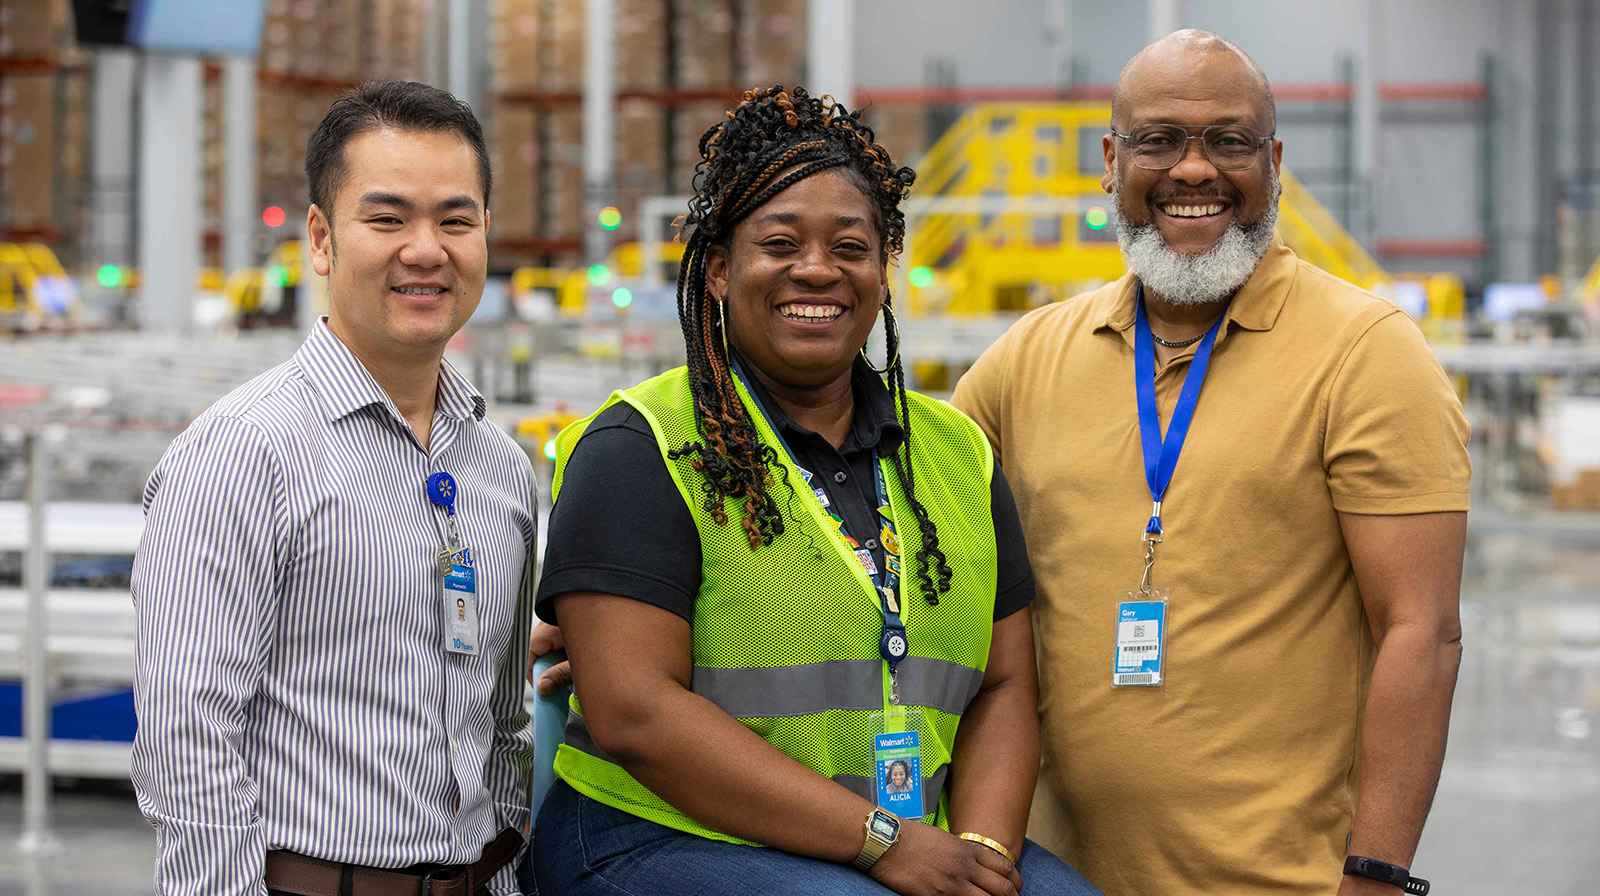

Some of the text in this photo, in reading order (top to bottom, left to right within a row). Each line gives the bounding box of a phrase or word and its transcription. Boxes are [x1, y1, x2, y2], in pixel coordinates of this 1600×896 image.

[1122, 609, 1136, 618] Gary
[453, 638, 473, 651] 10 Years
[880, 738, 905, 747] Walmart
[890, 793, 912, 802] ALICIA
